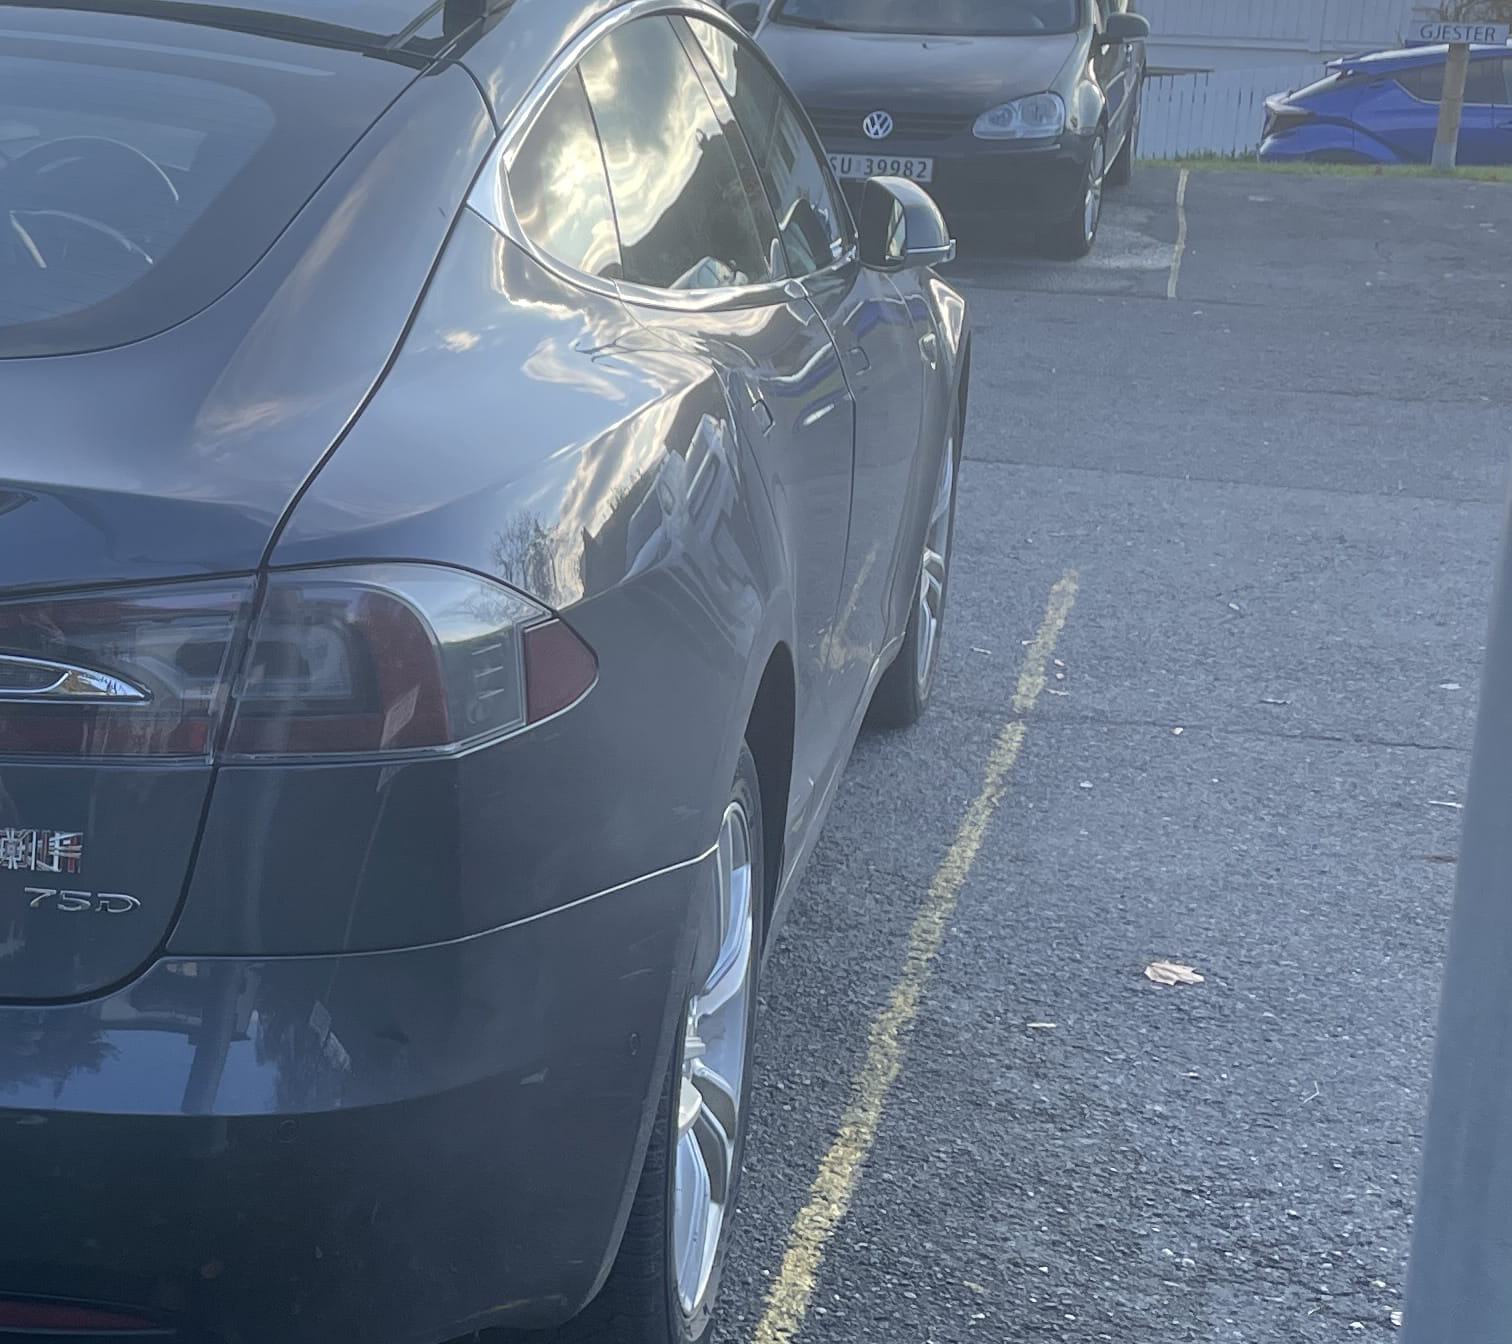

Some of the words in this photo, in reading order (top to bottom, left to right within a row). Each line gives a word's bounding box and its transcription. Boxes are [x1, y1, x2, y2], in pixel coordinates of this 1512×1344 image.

[1420, 24, 1496, 42] GJESTER
[863, 157, 928, 179] 39982
[23, 886, 142, 914] 75D
